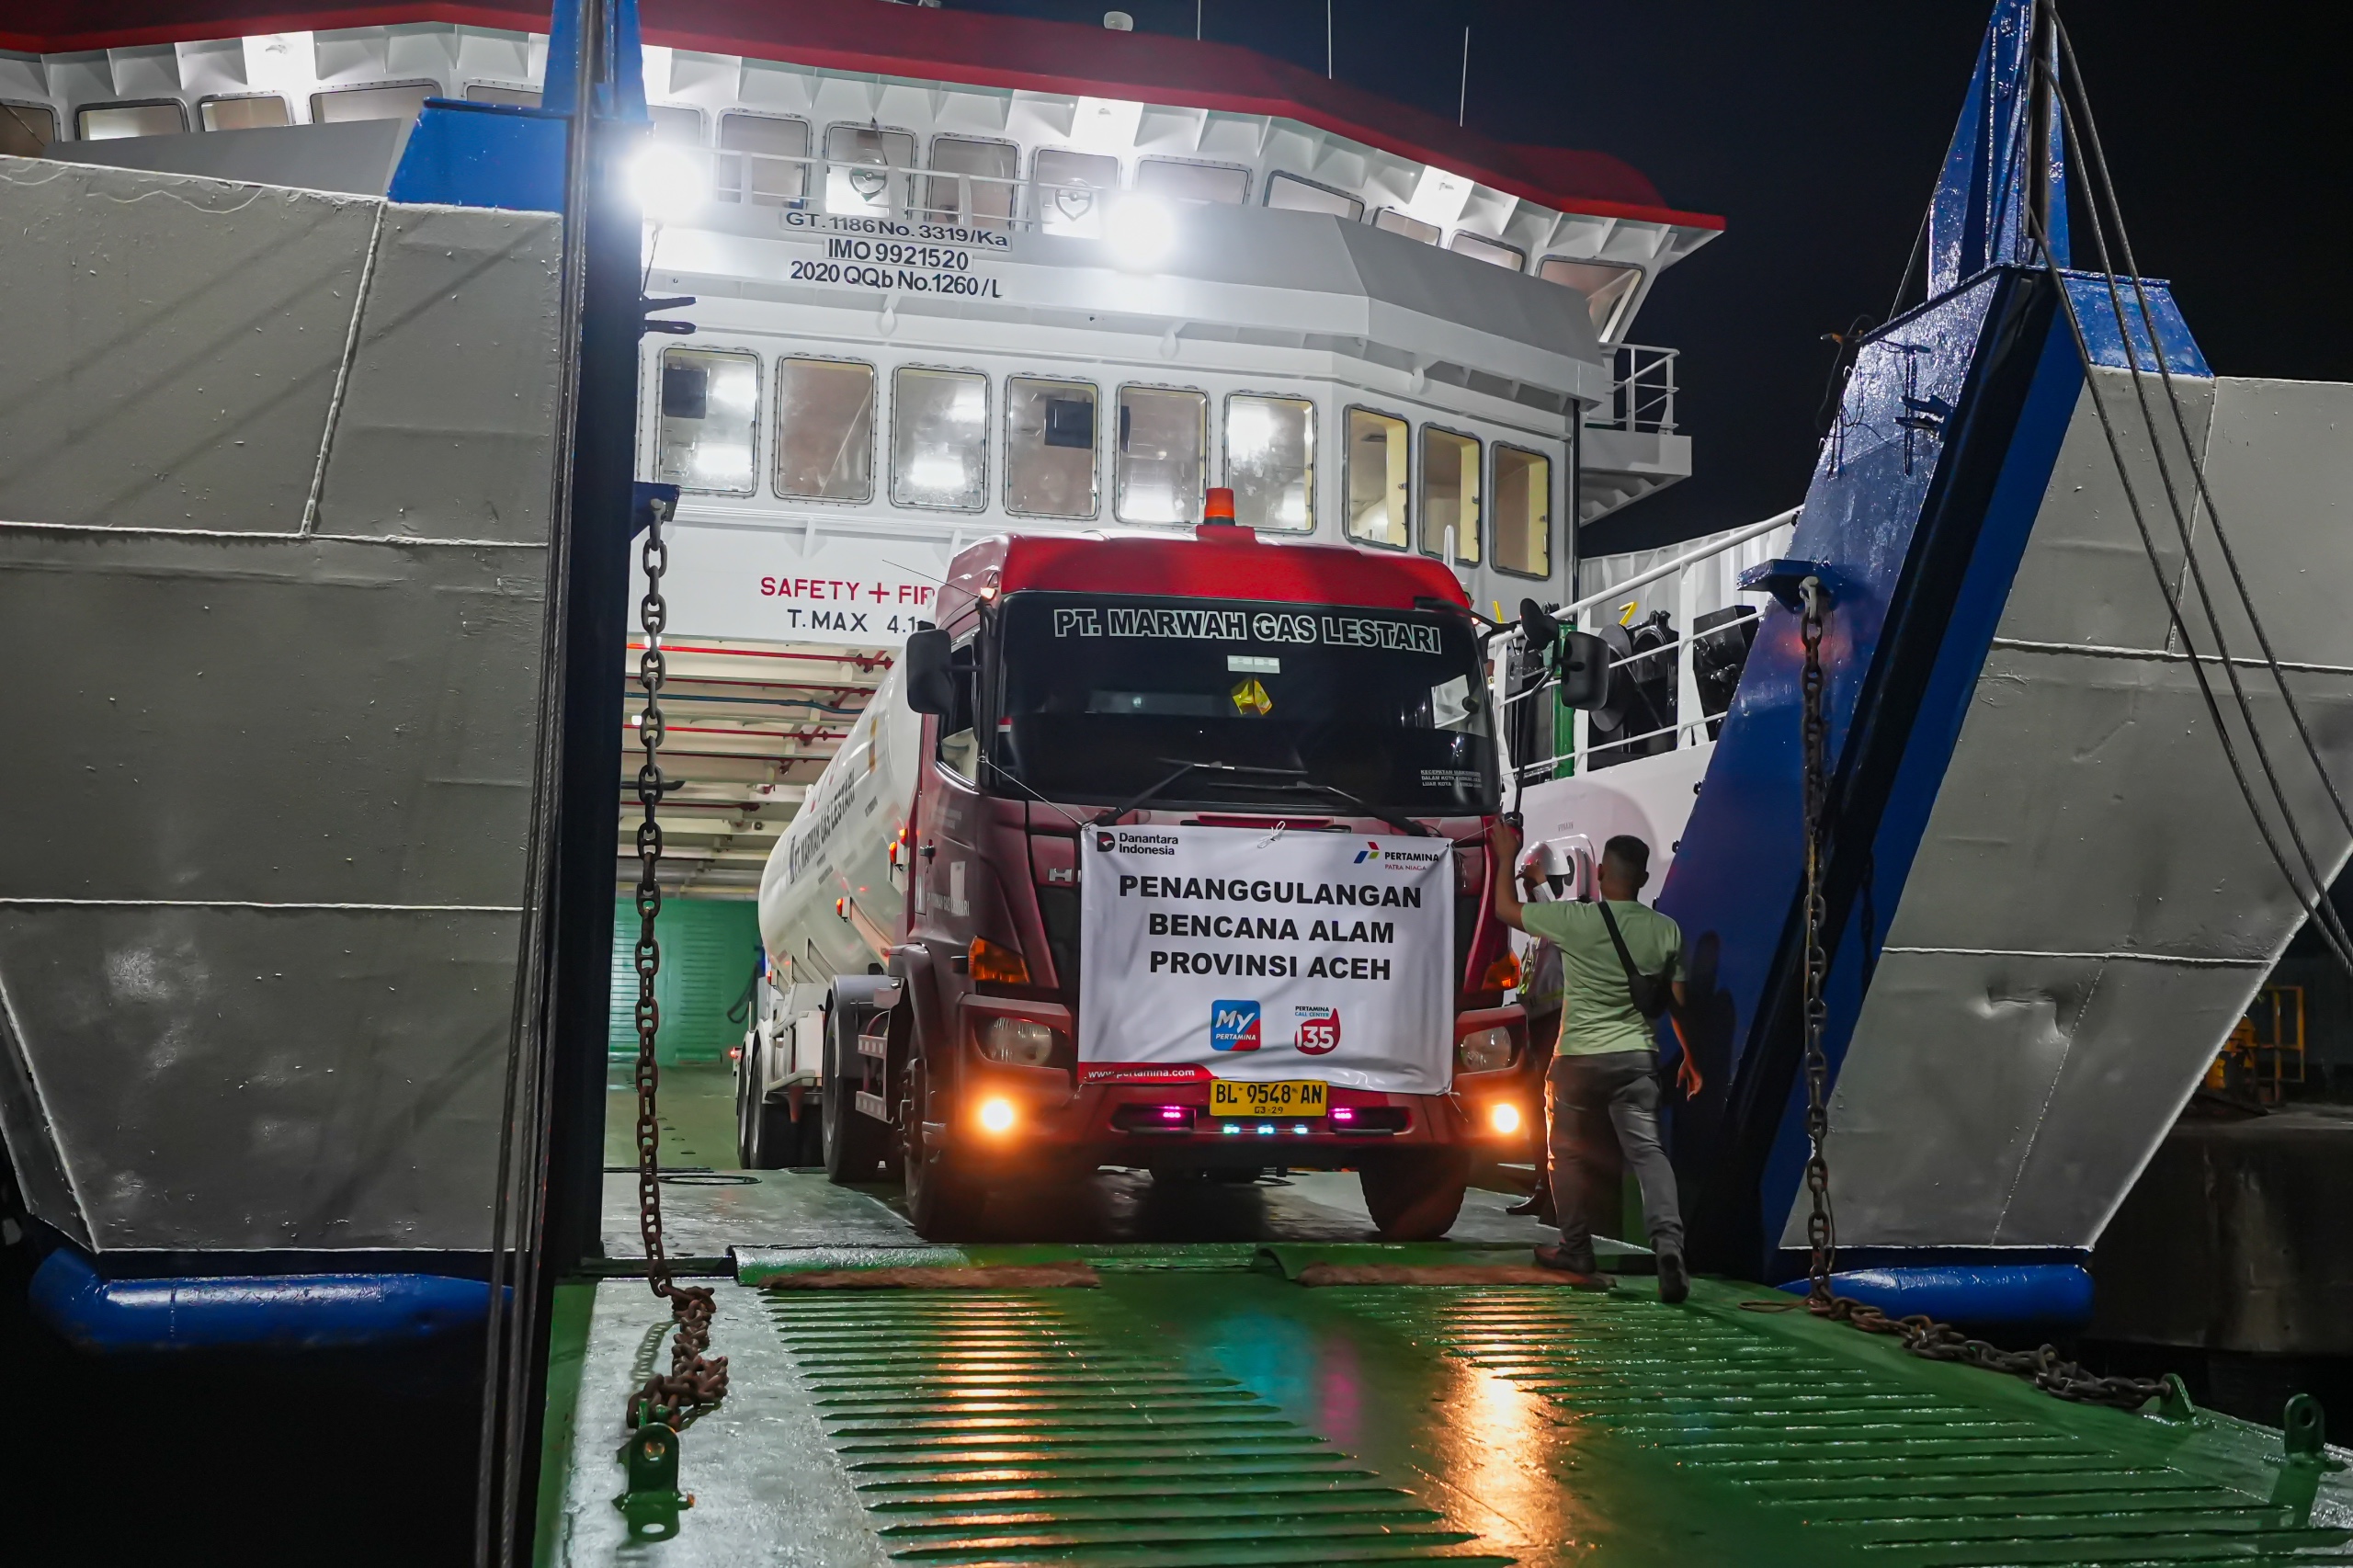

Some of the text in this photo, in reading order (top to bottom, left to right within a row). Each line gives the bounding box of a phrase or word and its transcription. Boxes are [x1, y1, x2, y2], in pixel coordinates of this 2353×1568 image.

[828, 238, 969, 270] IMO 9921520
[790, 260, 840, 282] 2020
[760, 576, 859, 600] SAFETY
[1054, 608, 1442, 654] PT. MARWAH GAS LESTARI
[1119, 833, 1178, 845] Danantara
[1119, 844, 1176, 856] Indonesia
[1384, 851, 1439, 862] PERTAMINA
[1119, 875, 1421, 909] PENANGGULANGAN
[1149, 913, 1394, 943] BENCANA ALAM
[1150, 951, 1391, 981] PROVINSI ACEH
[1296, 1025, 1335, 1049] 135
[1216, 1084, 1322, 1104] BL 9548 AN
